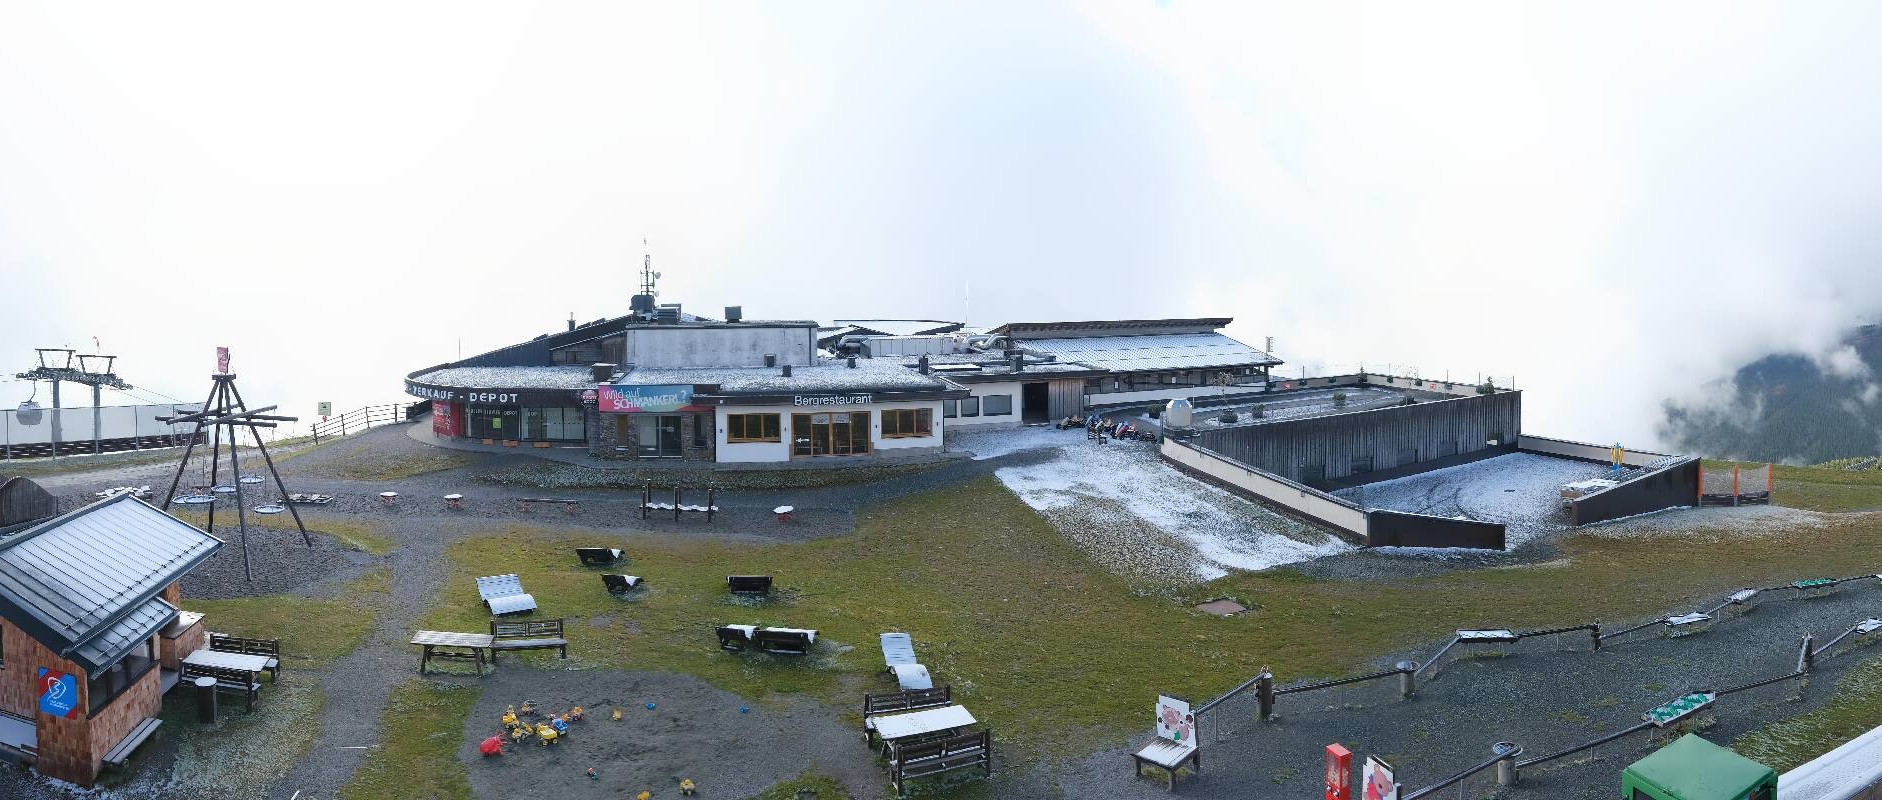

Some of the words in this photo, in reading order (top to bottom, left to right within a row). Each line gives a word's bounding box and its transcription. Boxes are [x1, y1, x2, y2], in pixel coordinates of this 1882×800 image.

[413, 386, 454, 400] VERKAUF
[469, 392, 518, 403] DEPOT
[603, 389, 624, 400] Wild
[625, 387, 640, 399] auf
[794, 394, 873, 407] Bergrestaurant
